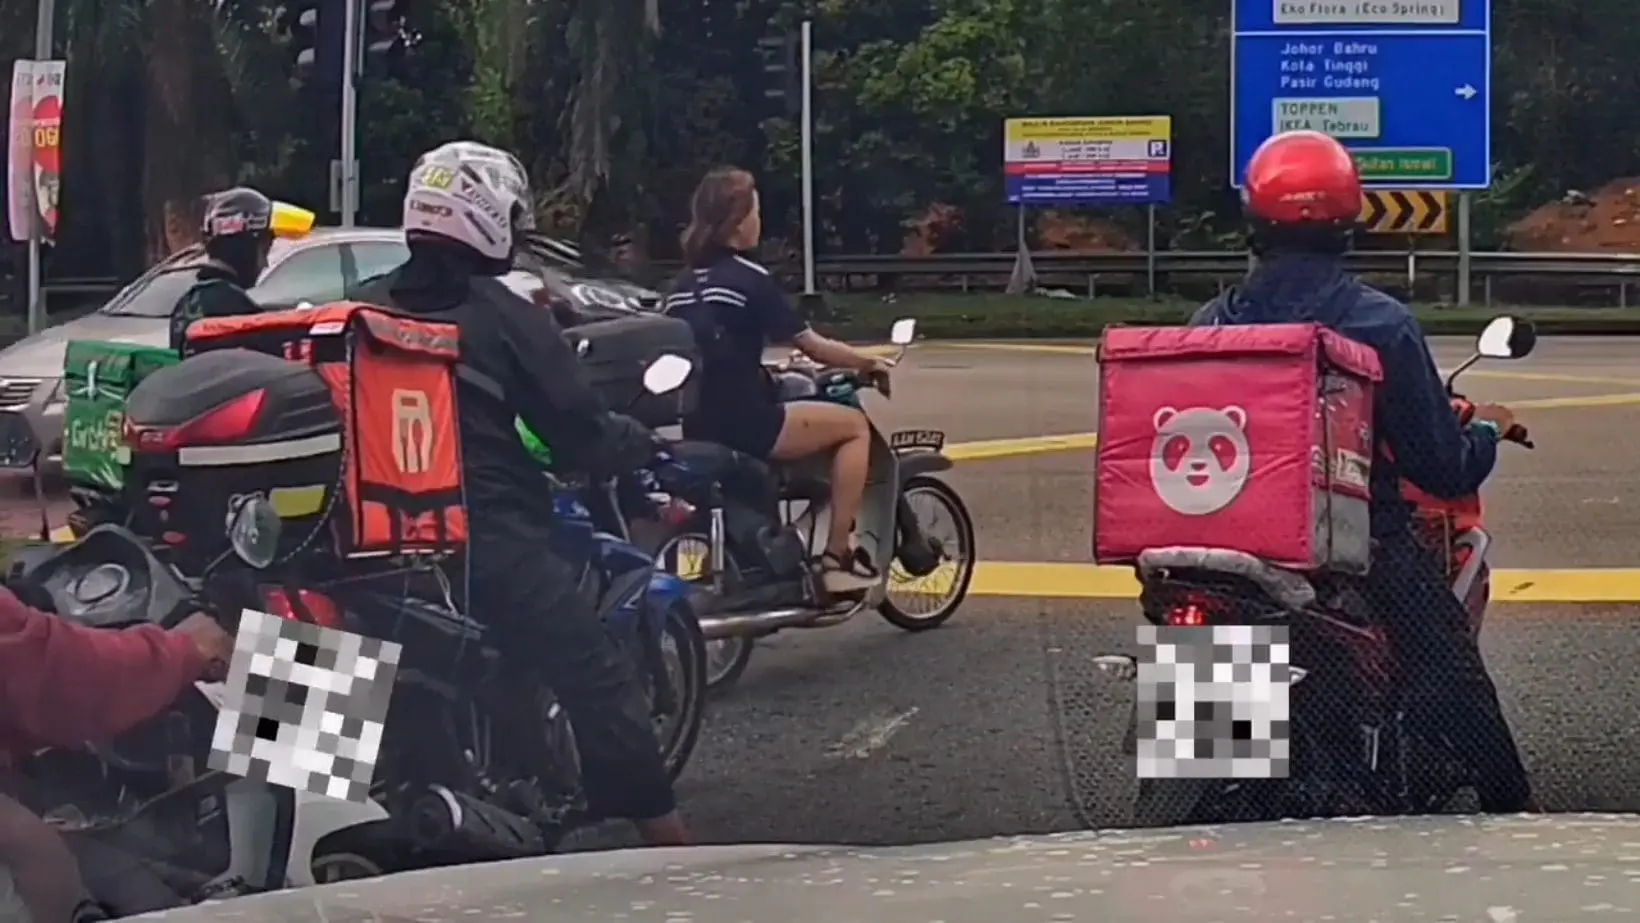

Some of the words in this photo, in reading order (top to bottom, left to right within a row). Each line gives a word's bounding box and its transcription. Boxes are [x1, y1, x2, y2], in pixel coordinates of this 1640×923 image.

[1310, 3, 1346, 15] Flora
[1392, 2, 1444, 16] Spring)
[1280, 43, 1323, 55] Johor
[1333, 42, 1377, 55] Bahru
[1281, 60, 1314, 72] Kota
[1324, 58, 1368, 74] Tinggi
[1280, 75, 1317, 88] Pasir
[1323, 75, 1379, 91] Gudang
[1281, 102, 1337, 116] TOPPEN
[1280, 119, 1311, 132] IKEA
[1322, 119, 1369, 132] Tebrau
